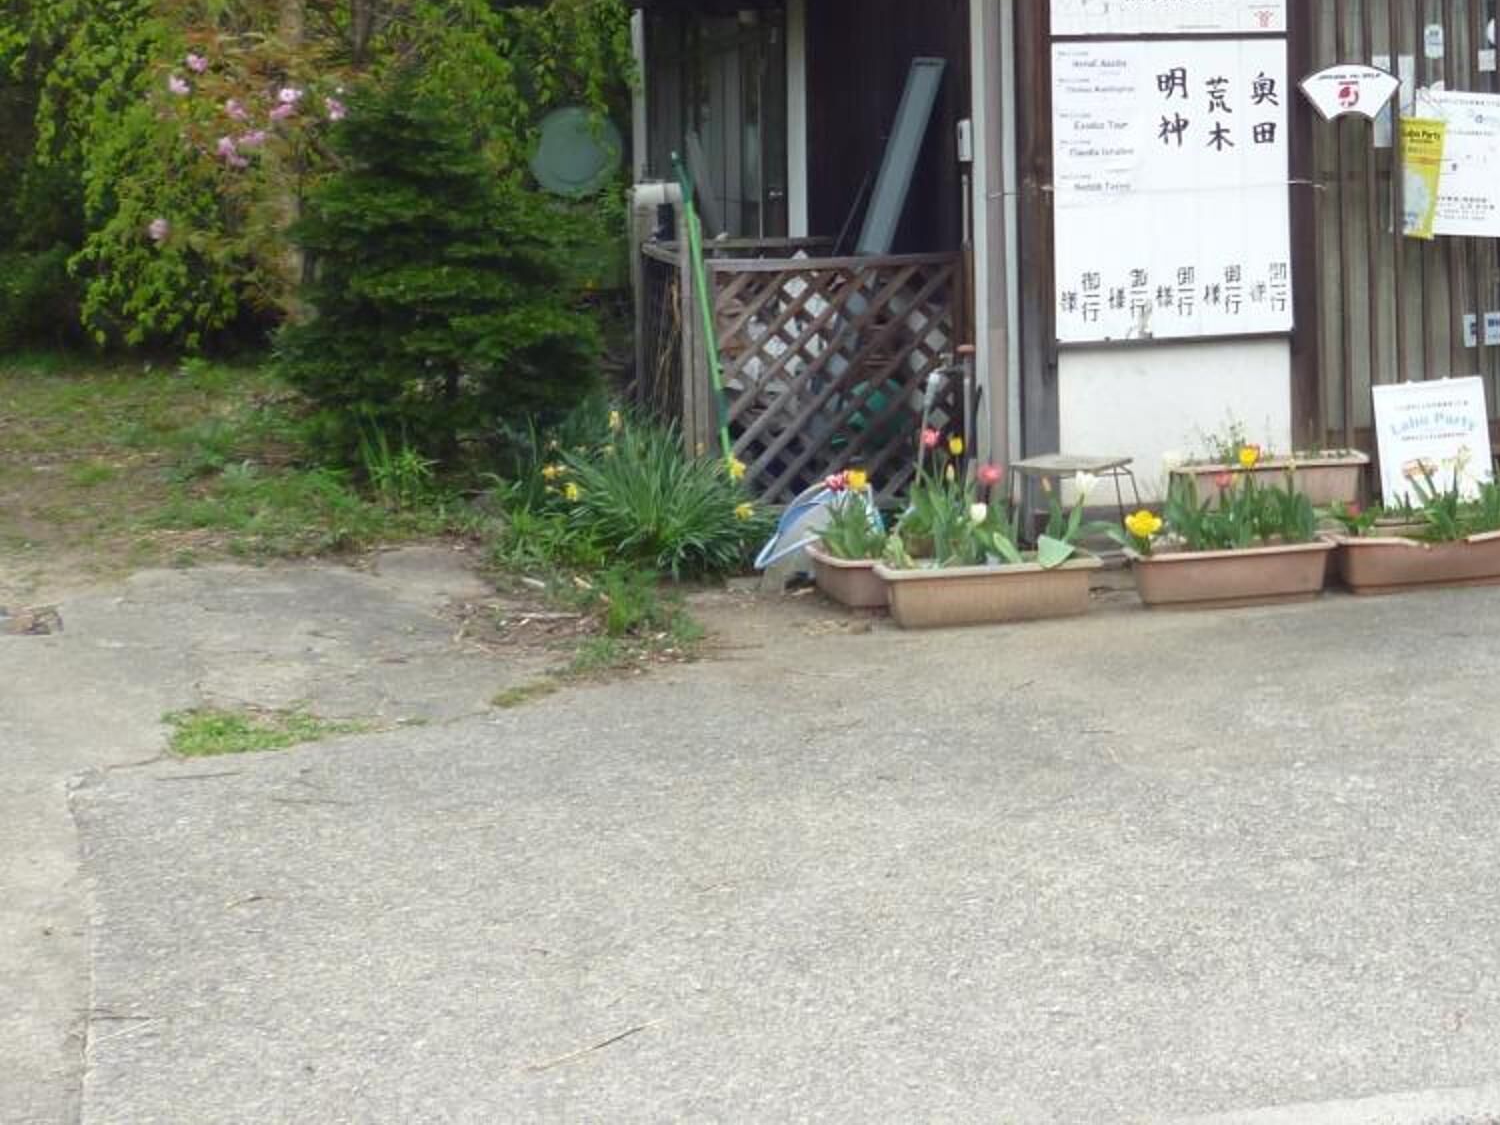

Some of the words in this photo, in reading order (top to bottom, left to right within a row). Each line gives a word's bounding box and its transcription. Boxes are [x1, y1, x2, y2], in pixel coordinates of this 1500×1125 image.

[1156, 66, 1190, 148] 明神
[1205, 75, 1235, 152] 荒木
[1250, 71, 1280, 144] 奥田
